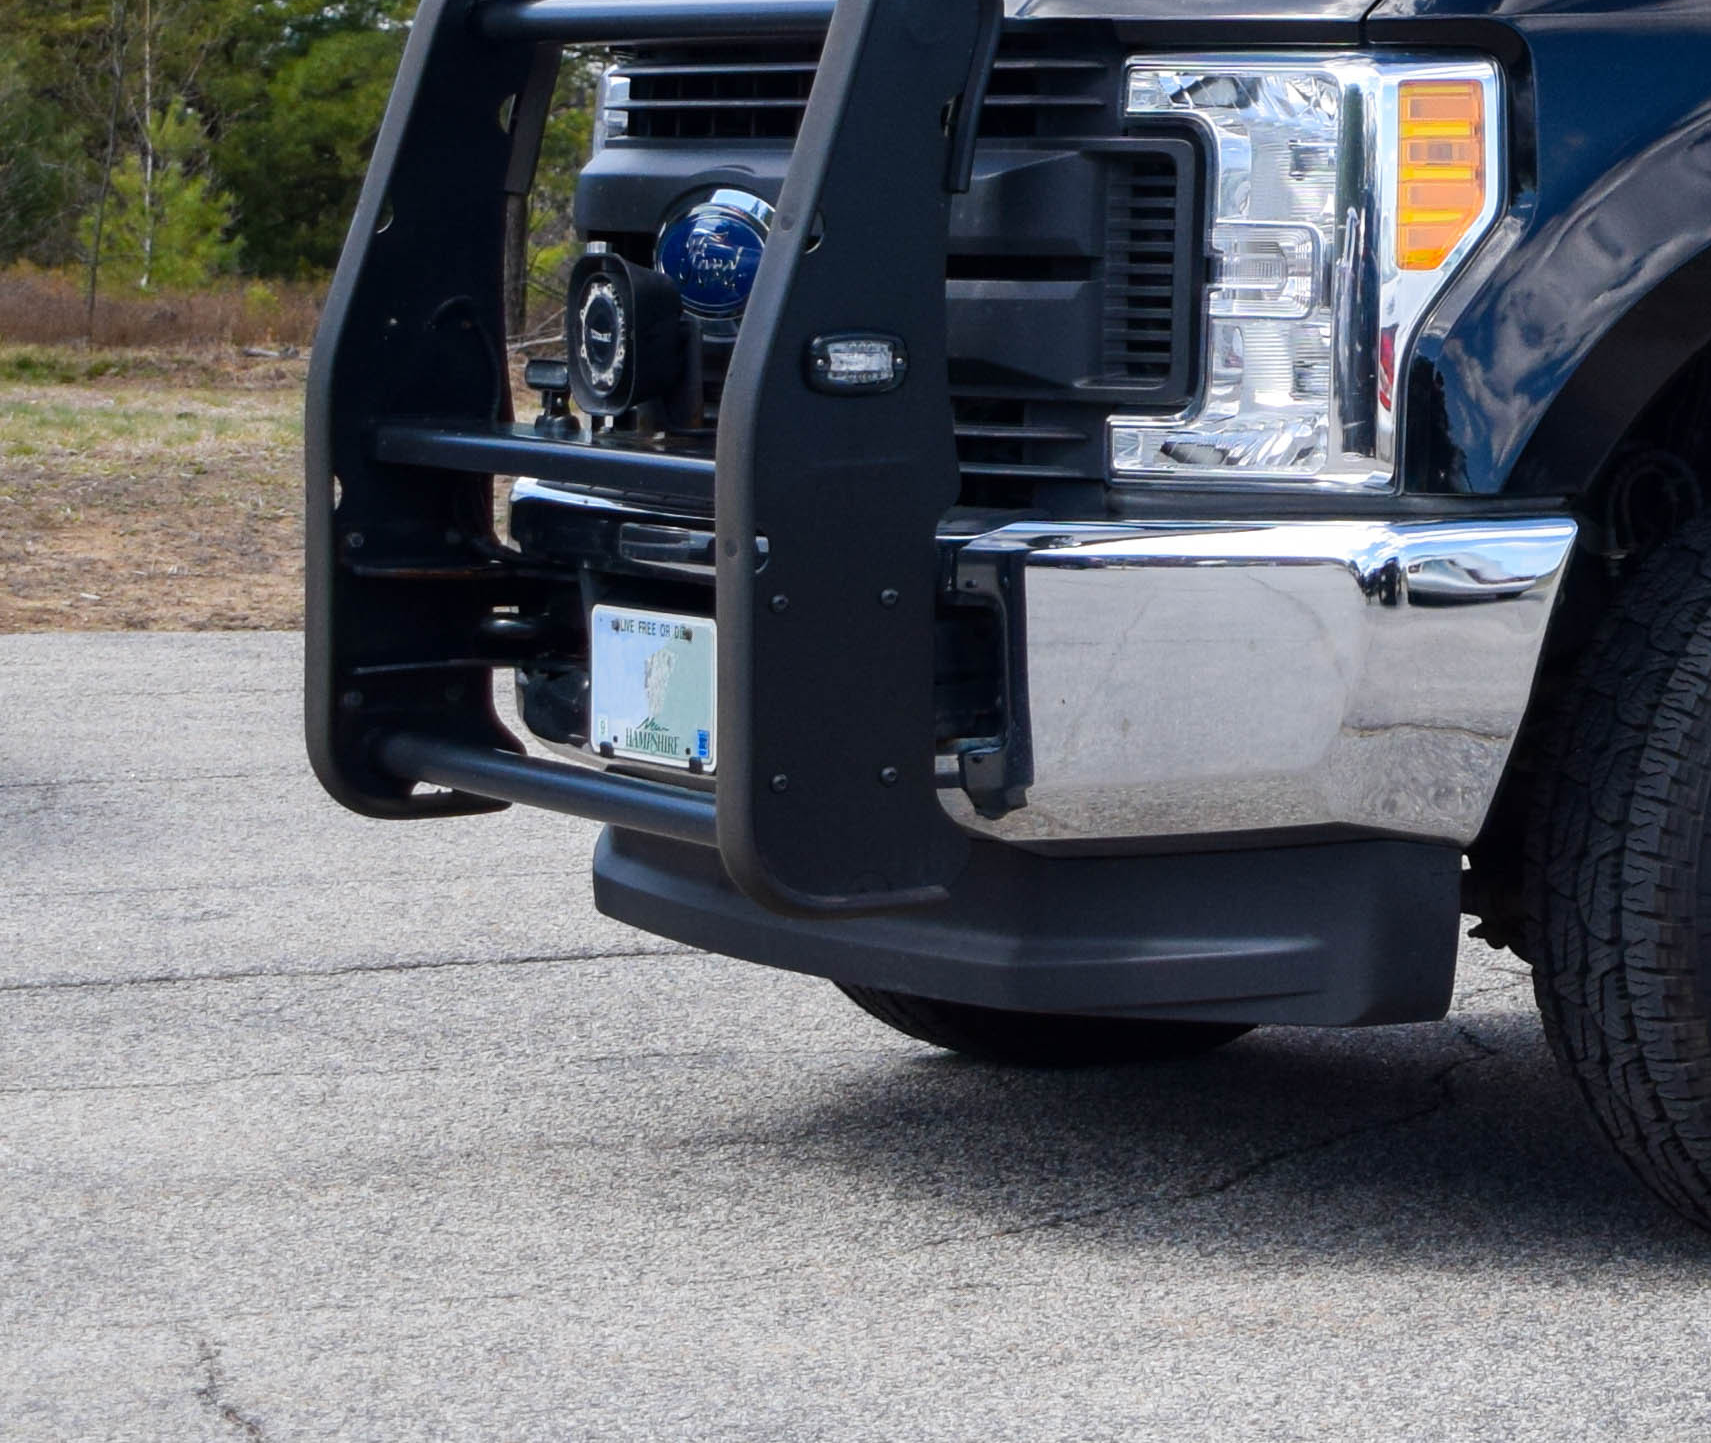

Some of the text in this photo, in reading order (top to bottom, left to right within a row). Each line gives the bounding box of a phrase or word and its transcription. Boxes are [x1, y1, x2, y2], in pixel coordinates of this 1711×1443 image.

[620, 619, 635, 633] LIVE
[638, 621, 657, 636] FREE
[660, 623, 671, 637] OR
[636, 716, 670, 732] New
[626, 727, 680, 755] HAMPSHIRE
